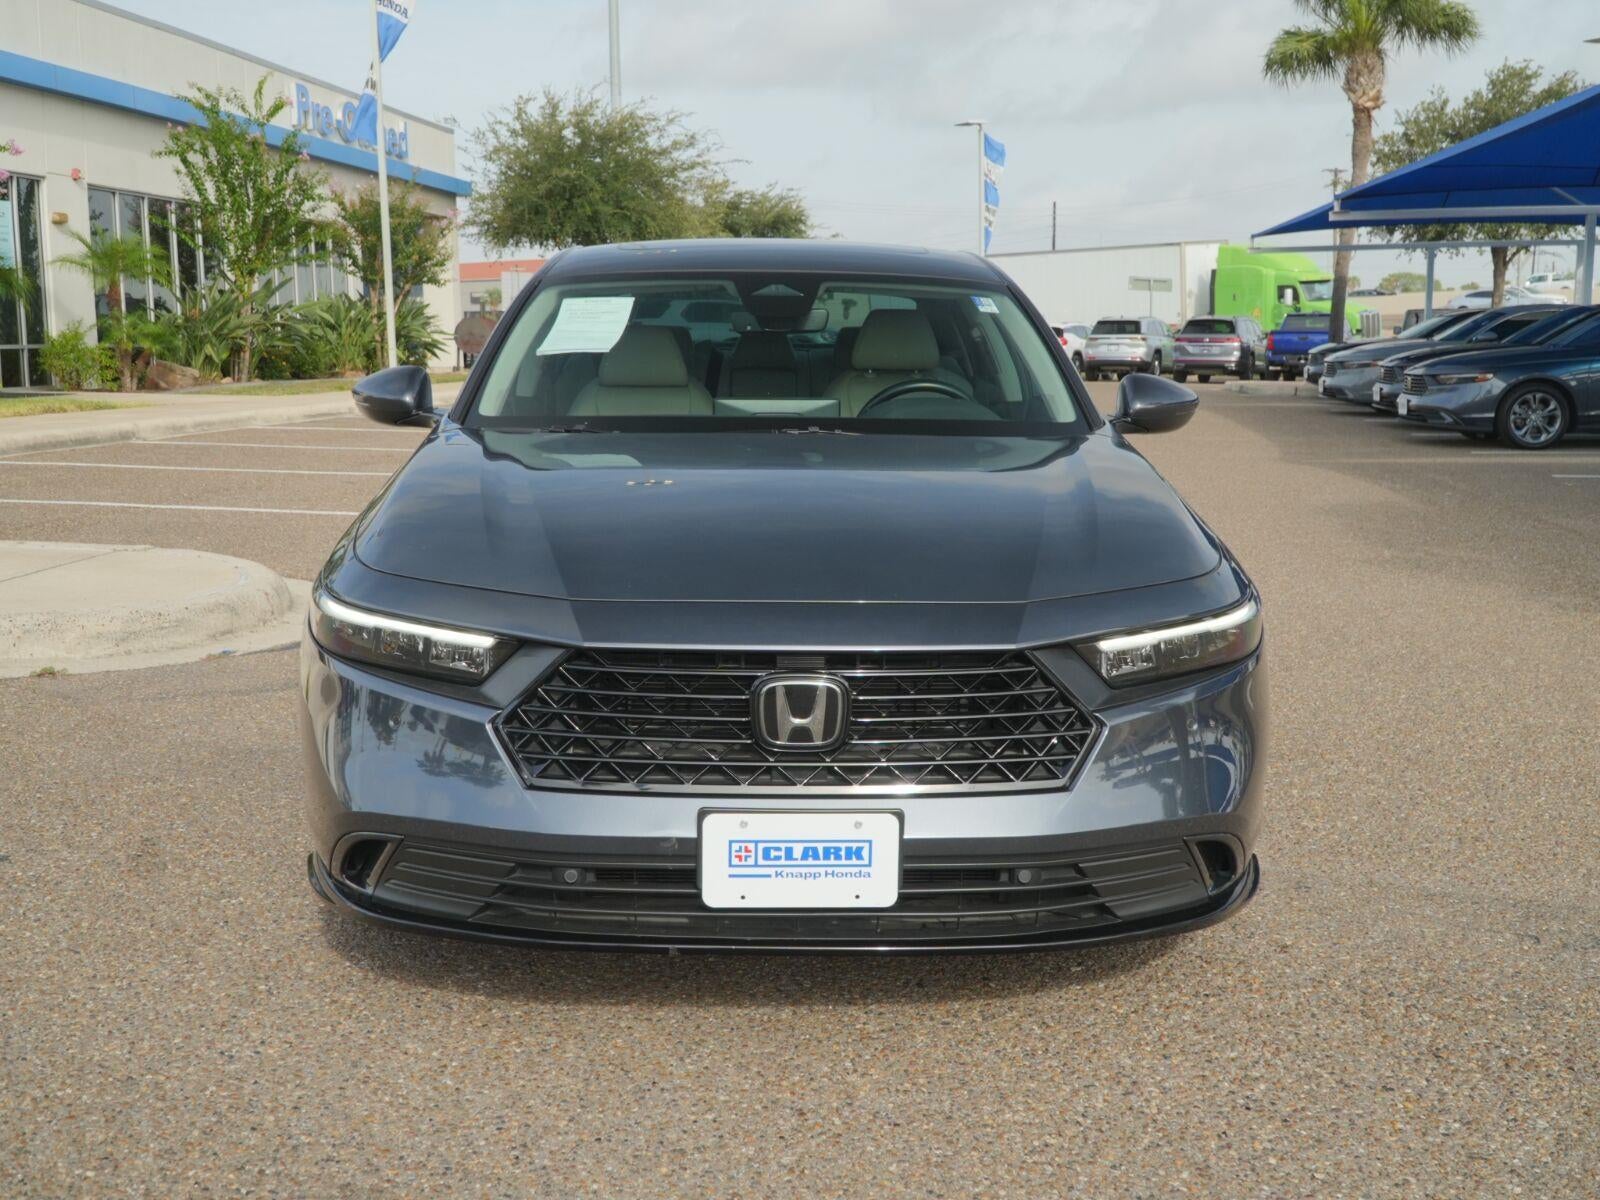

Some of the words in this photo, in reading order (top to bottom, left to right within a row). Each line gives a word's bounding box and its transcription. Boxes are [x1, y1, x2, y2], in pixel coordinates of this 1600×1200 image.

[294, 83, 408, 159] Pre-Oed
[762, 846, 865, 861] CLARK
[774, 869, 822, 880] Knapp
[824, 869, 872, 879] Honda
